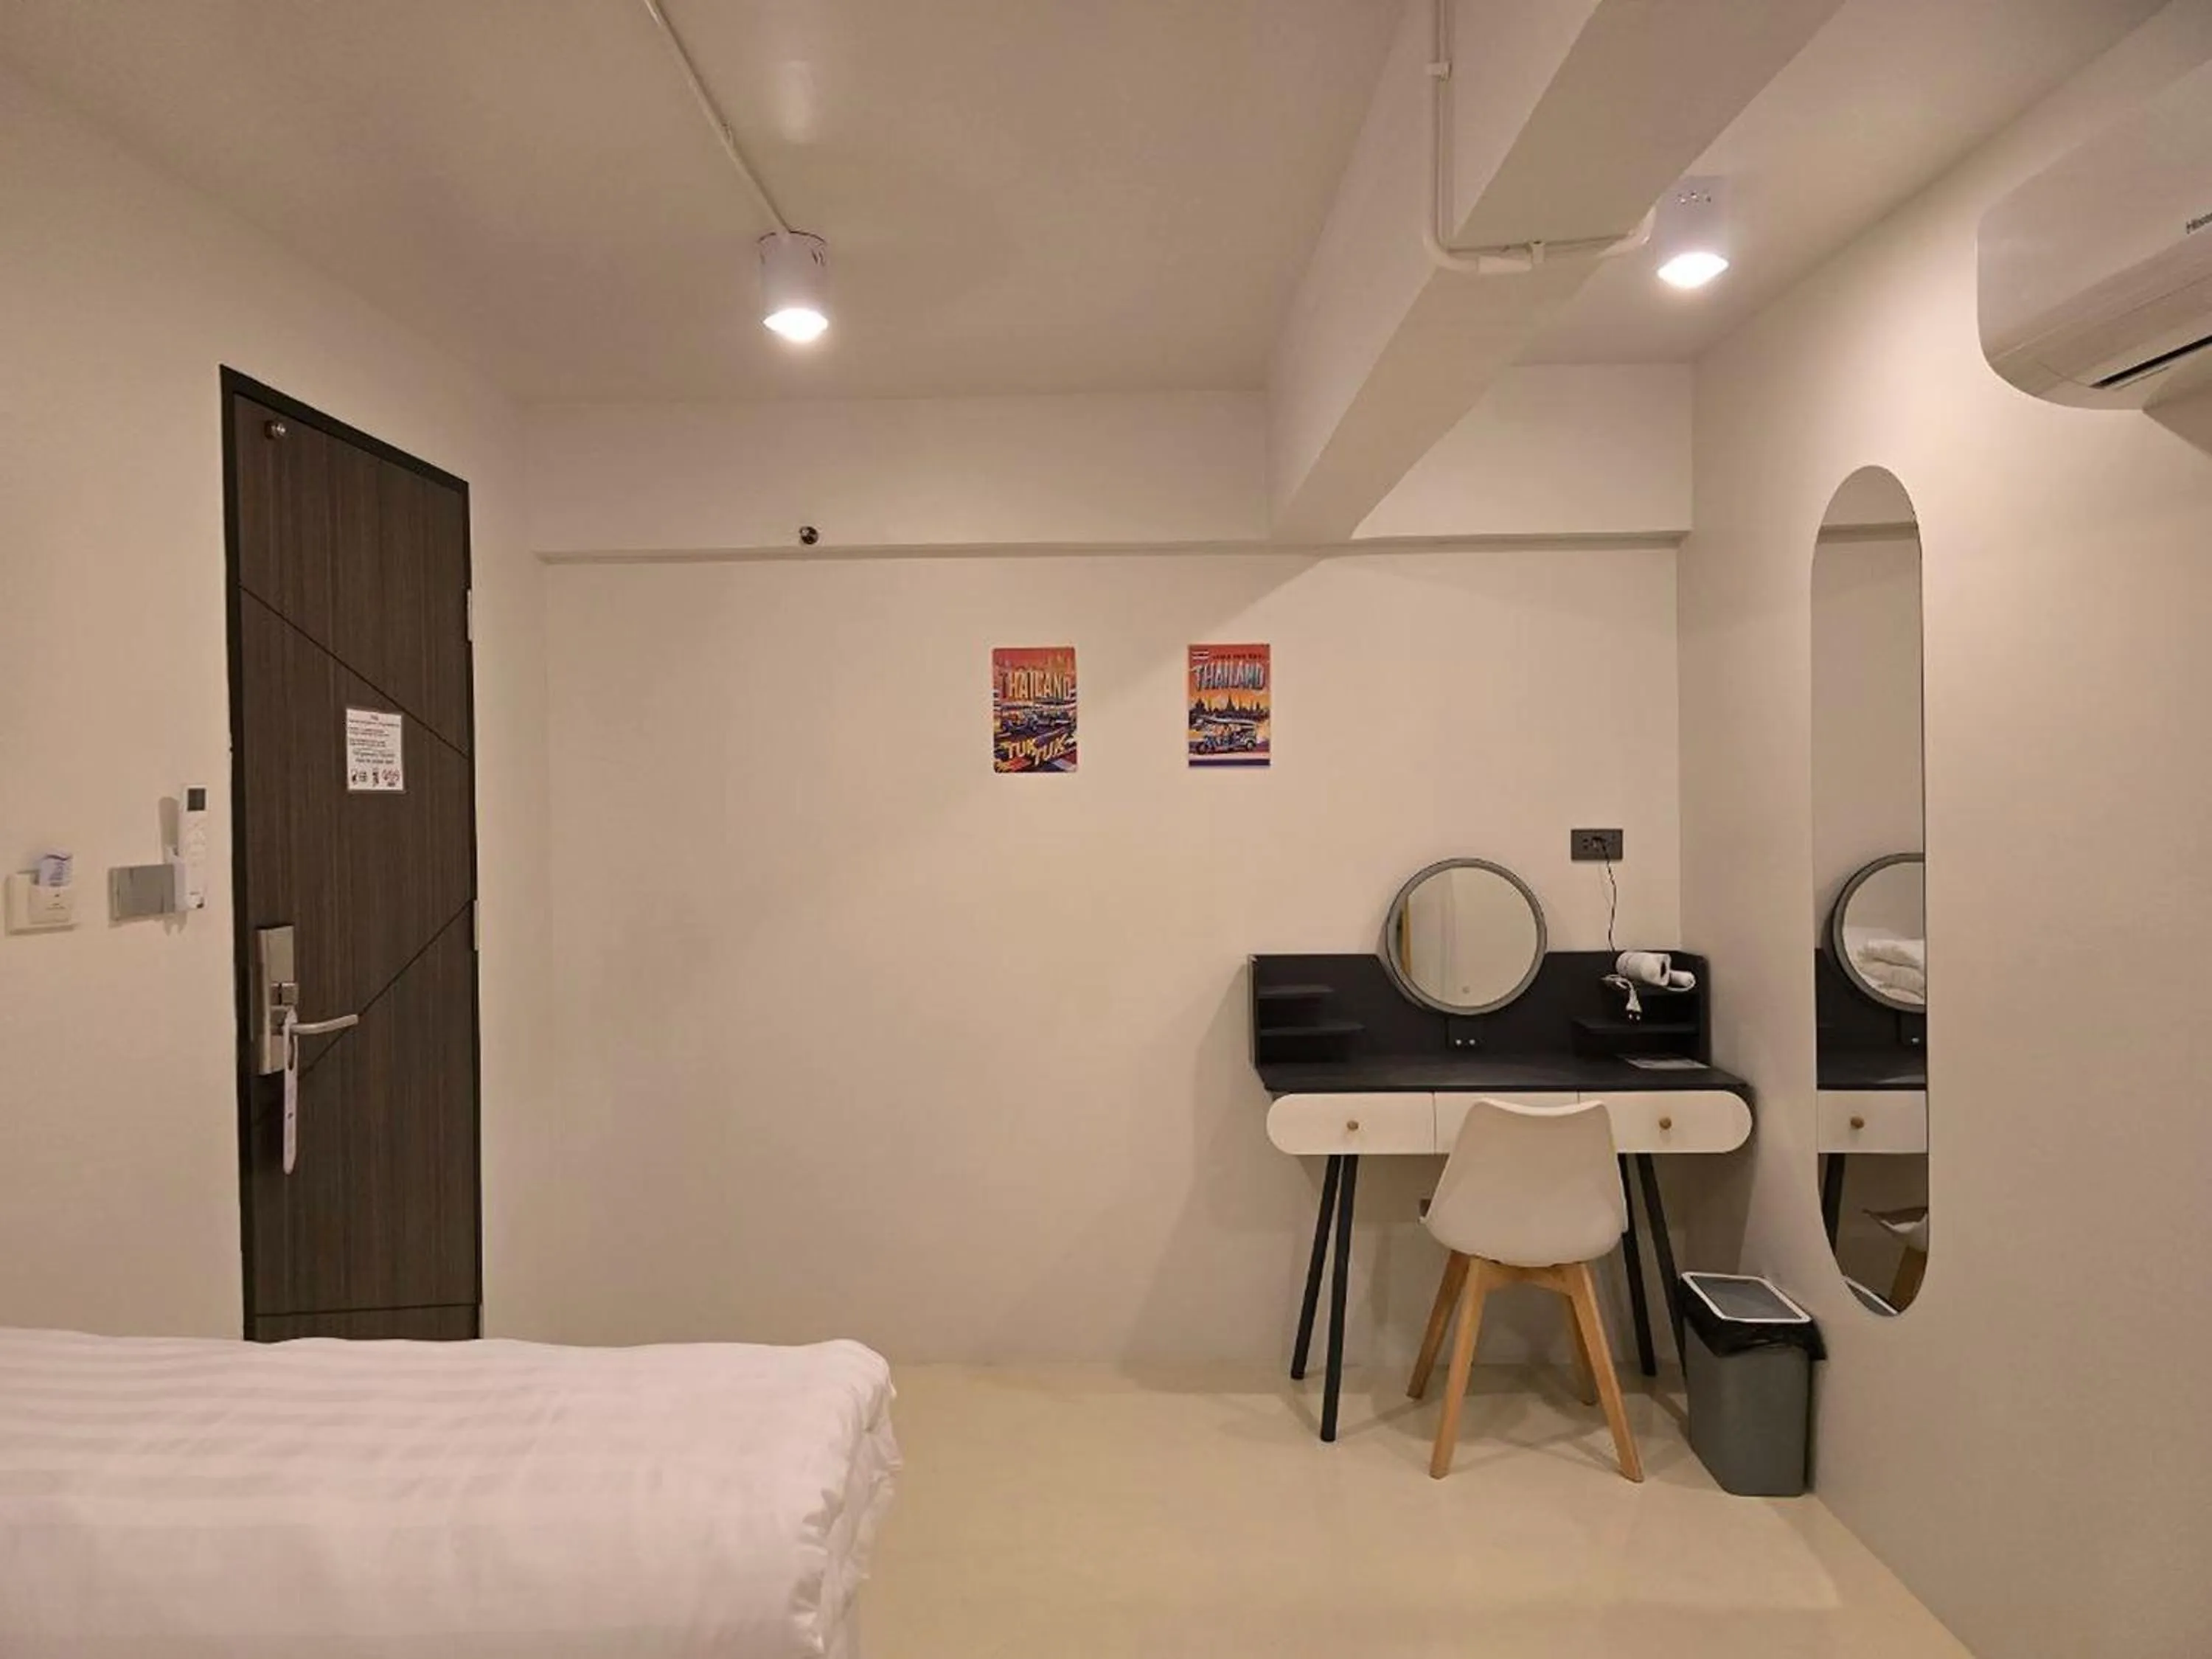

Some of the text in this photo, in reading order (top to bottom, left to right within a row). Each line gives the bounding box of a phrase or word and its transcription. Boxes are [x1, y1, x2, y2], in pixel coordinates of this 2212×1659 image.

[1191, 661, 1265, 690] THAILAND
[1001, 733, 1068, 766] TUK TUK
